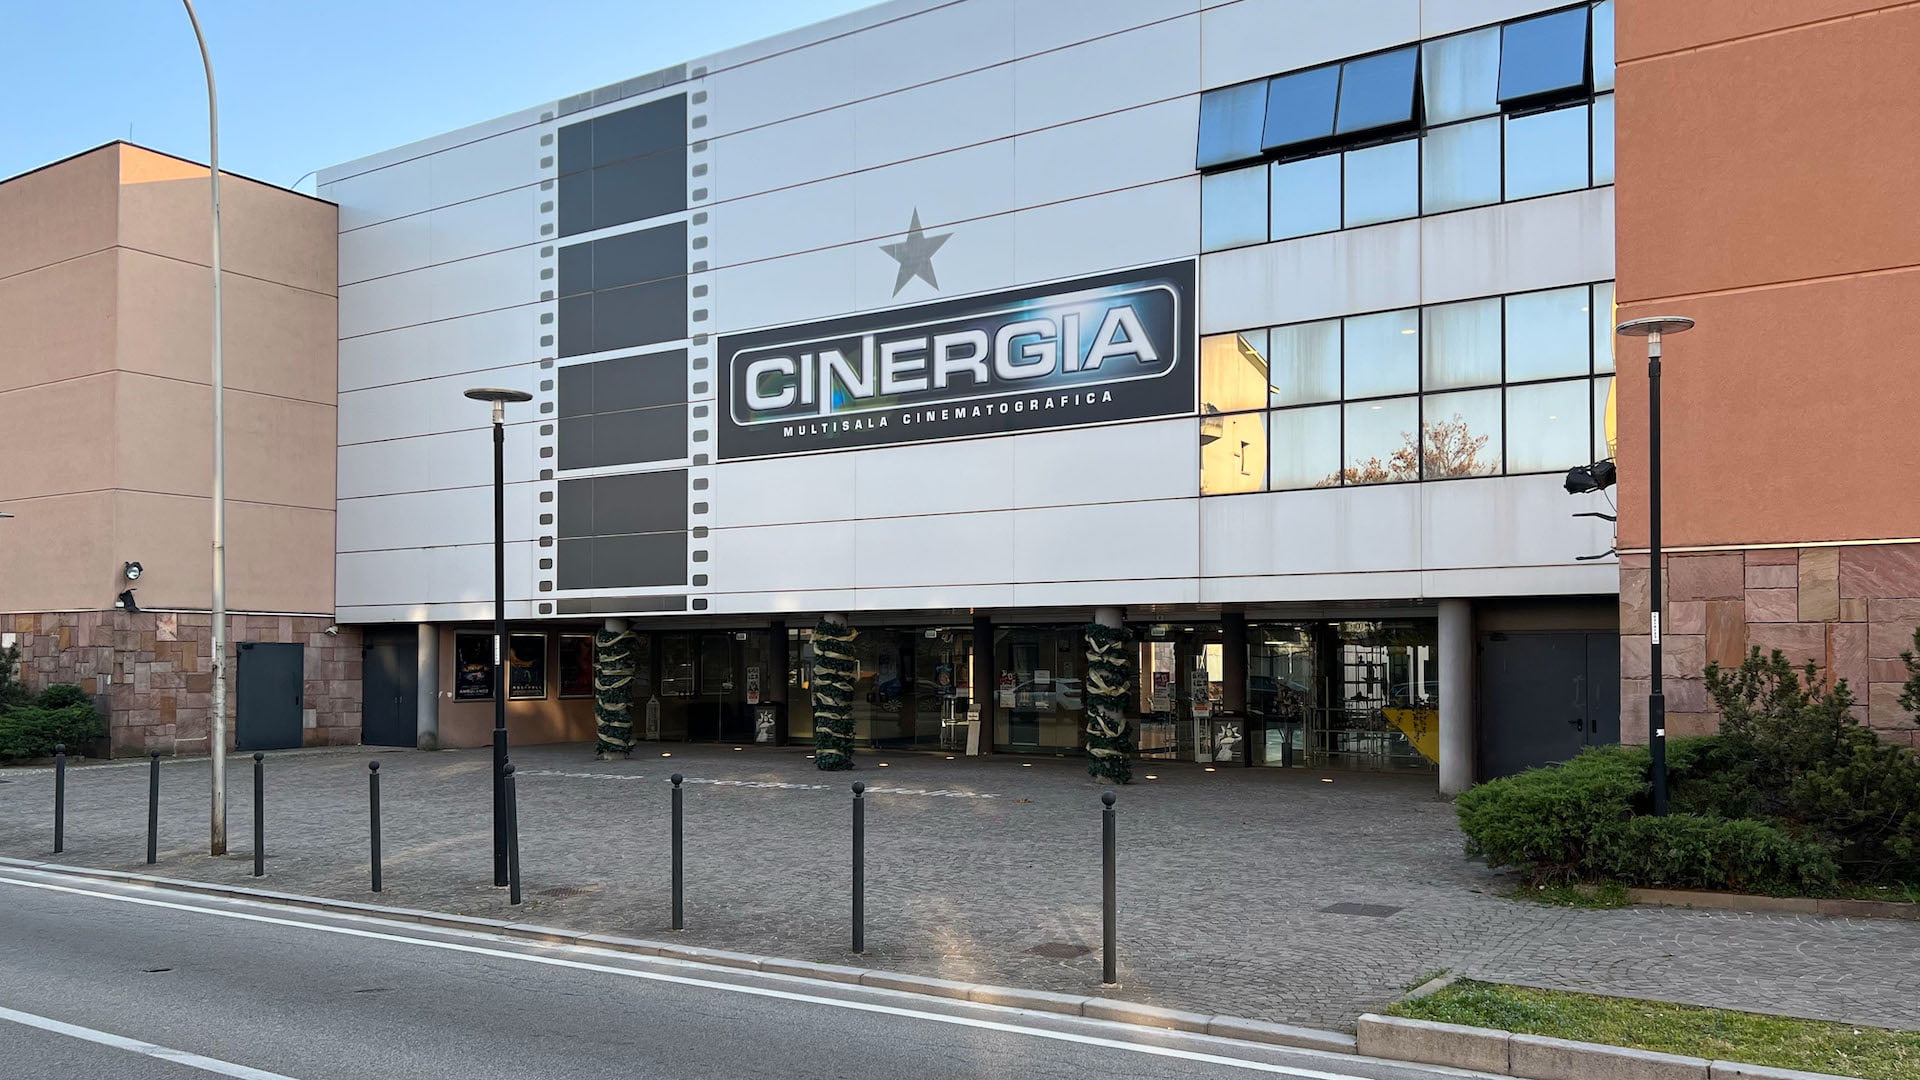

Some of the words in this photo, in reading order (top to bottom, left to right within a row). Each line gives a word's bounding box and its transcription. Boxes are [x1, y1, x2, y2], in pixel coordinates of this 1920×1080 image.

[745, 304, 1158, 415] CINERGIA
[783, 416, 889, 438] MULTISALA
[902, 390, 1113, 425] CINEMATOGRAFICA
